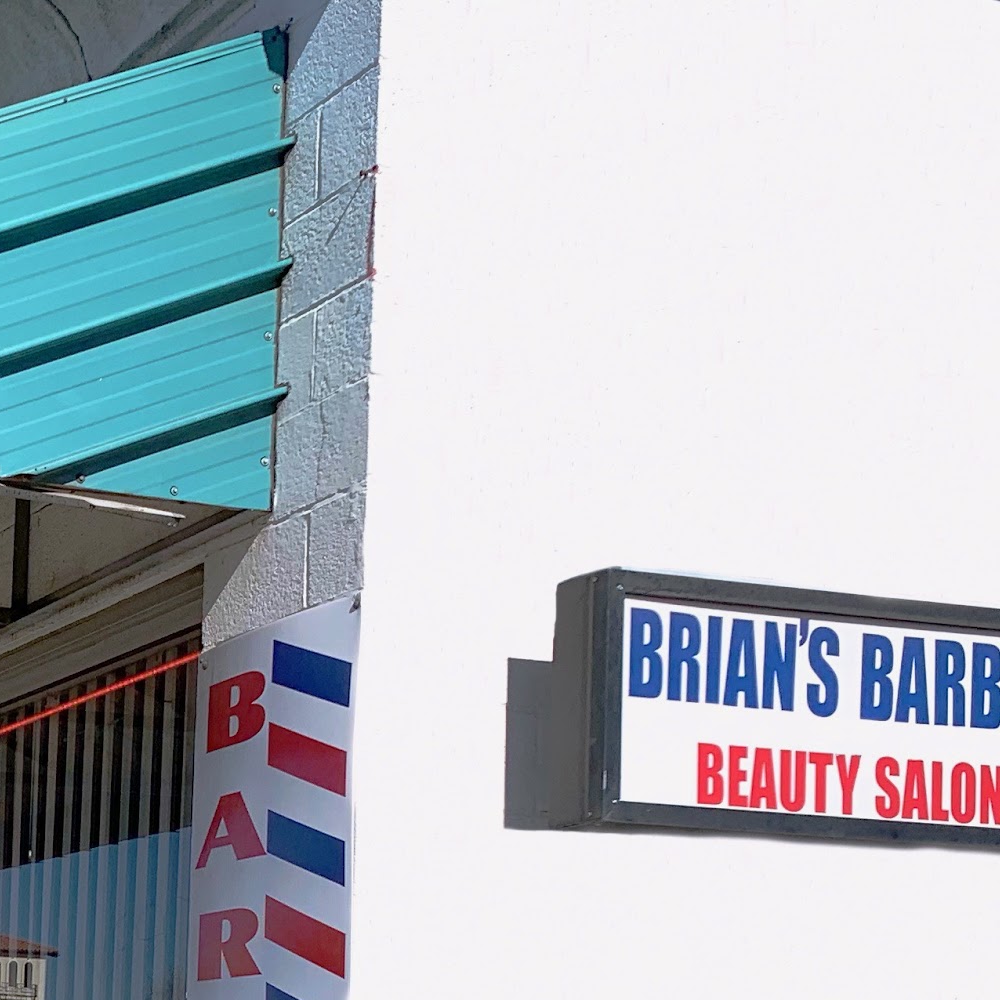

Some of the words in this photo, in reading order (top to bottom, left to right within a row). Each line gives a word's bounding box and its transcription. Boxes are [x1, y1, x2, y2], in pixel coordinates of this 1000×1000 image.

[628, 606, 840, 718] BRIAN'S
[859, 632, 1000, 730] BARB
[696, 741, 862, 816] BEAUTY
[874, 755, 1000, 826] SALON
